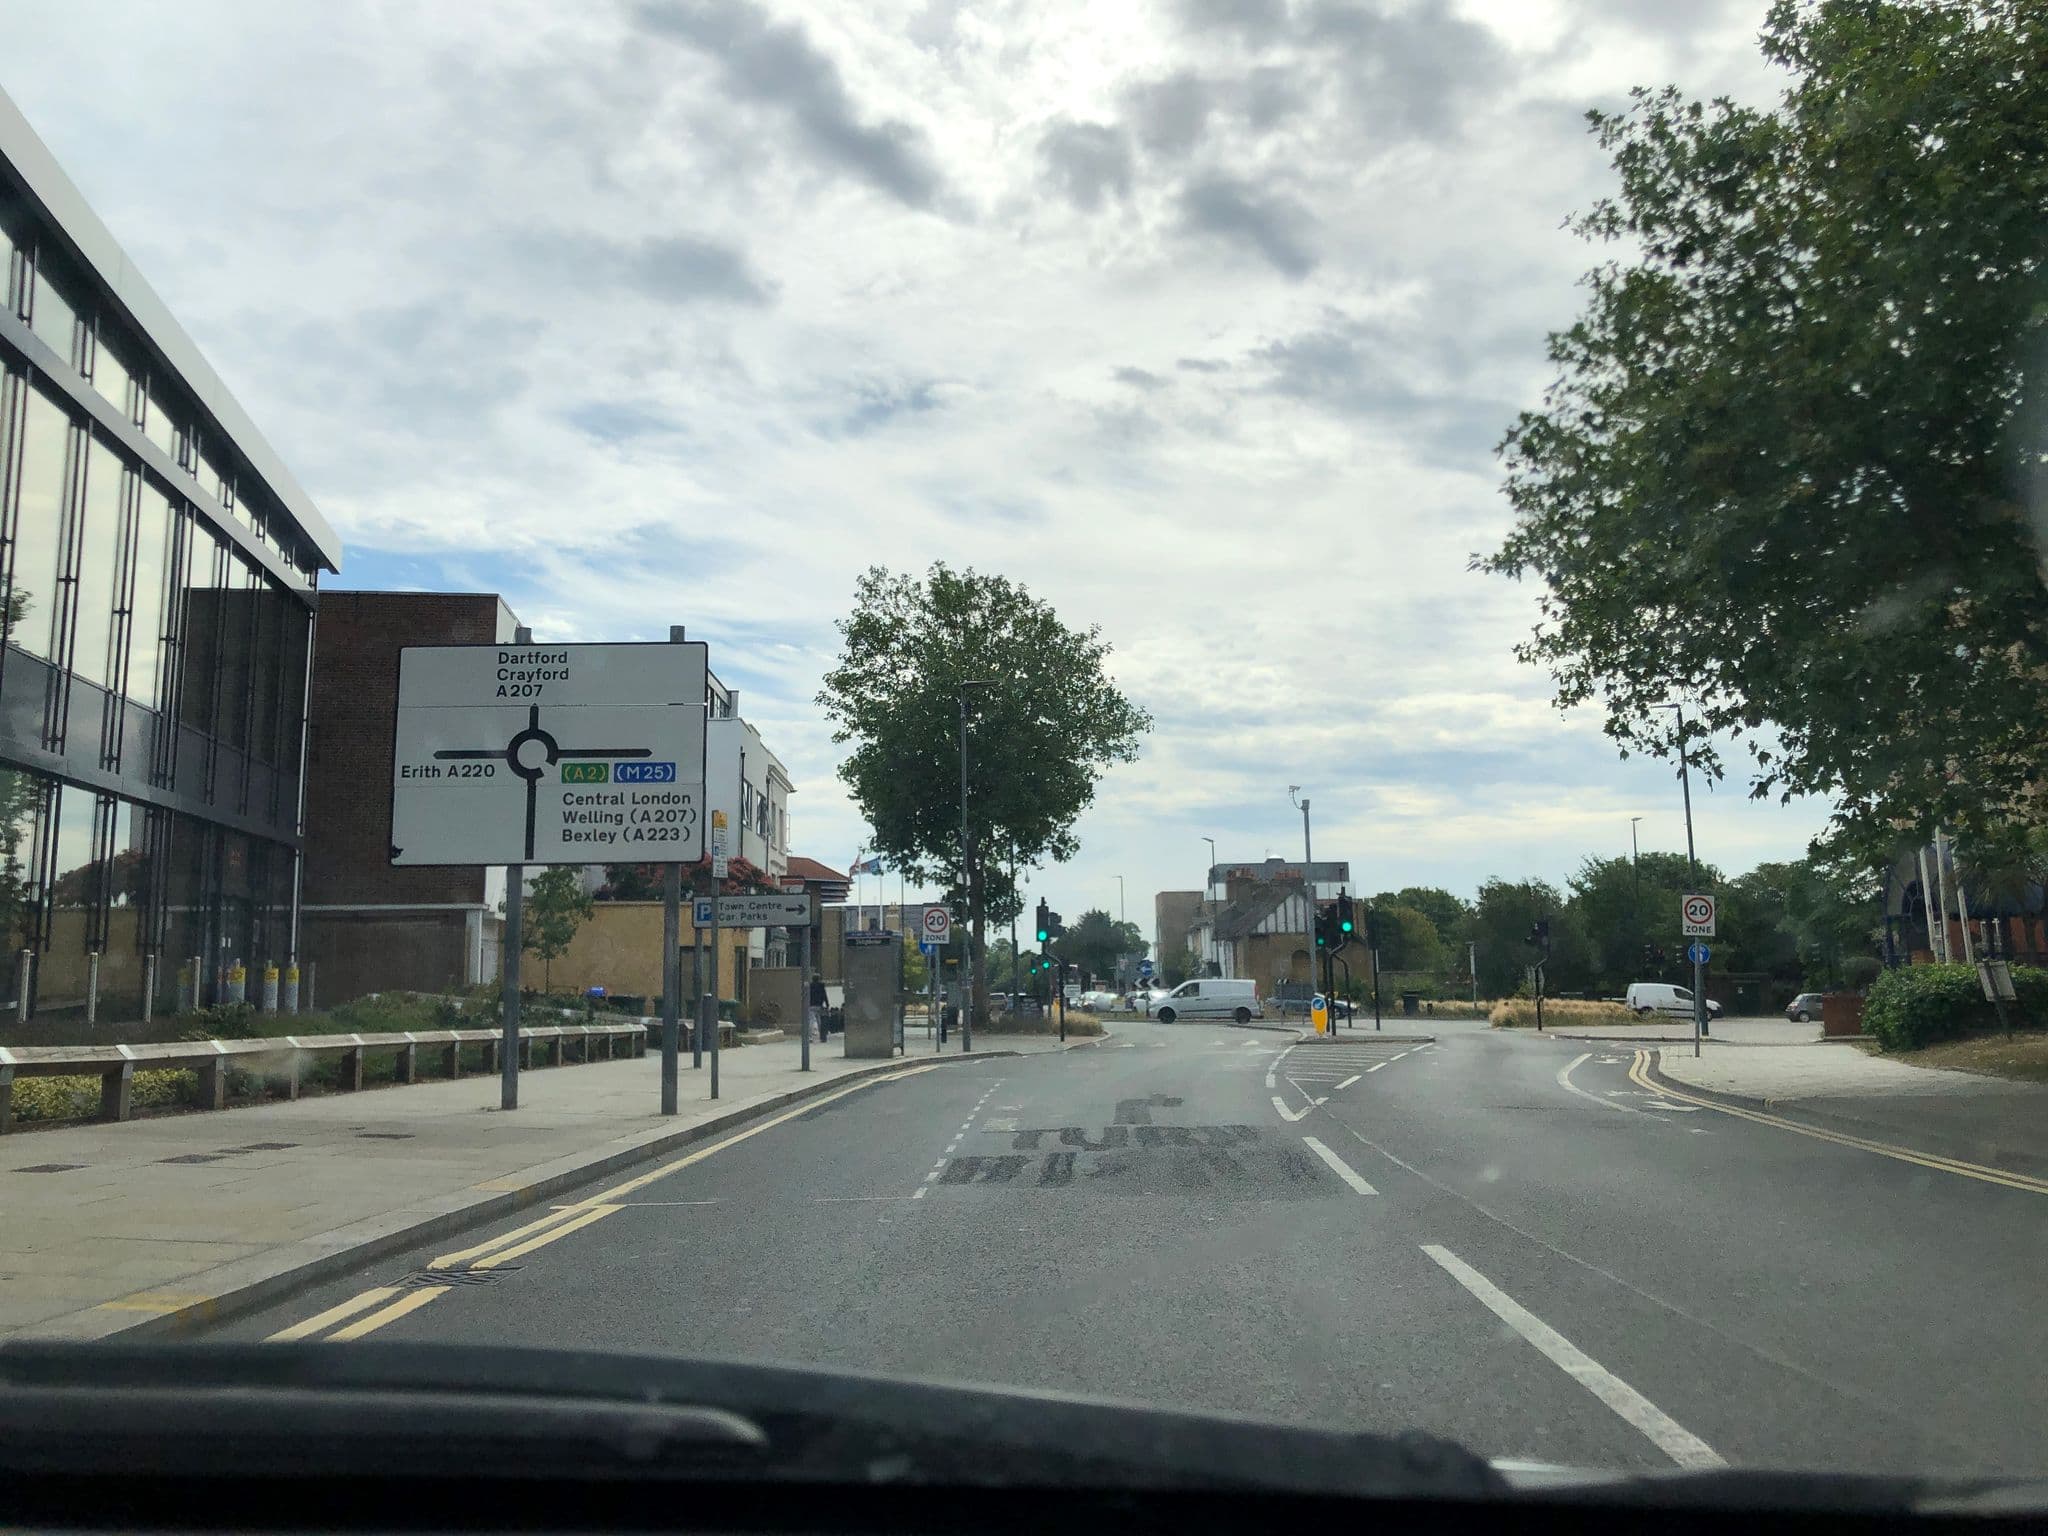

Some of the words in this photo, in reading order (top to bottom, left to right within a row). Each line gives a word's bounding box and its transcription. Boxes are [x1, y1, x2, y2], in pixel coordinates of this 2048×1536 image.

[498, 651, 568, 665] Dartford
[496, 668, 569, 683] Crayford
[496, 685, 543, 697] A207
[401, 765, 441, 778] Erith
[447, 764, 495, 778] A220
[565, 765, 606, 781] (A2)
[616, 764, 673, 781] (M25)
[562, 792, 625, 806] Central
[632, 792, 691, 805] London
[562, 810, 624, 825] Welling
[630, 808, 696, 824] (A207)
[562, 828, 617, 844] Bexley
[623, 826, 690, 843] (A223)
[719, 902, 744, 911] Town
[749, 902, 783, 910] Centre
[1689, 905, 1708, 916] 20
[719, 912, 734, 921] Car
[740, 911, 768, 920] Parks
[929, 916, 944, 926] 20
[1686, 926, 1712, 934] ZONE
[925, 934, 945, 942] ZONE
